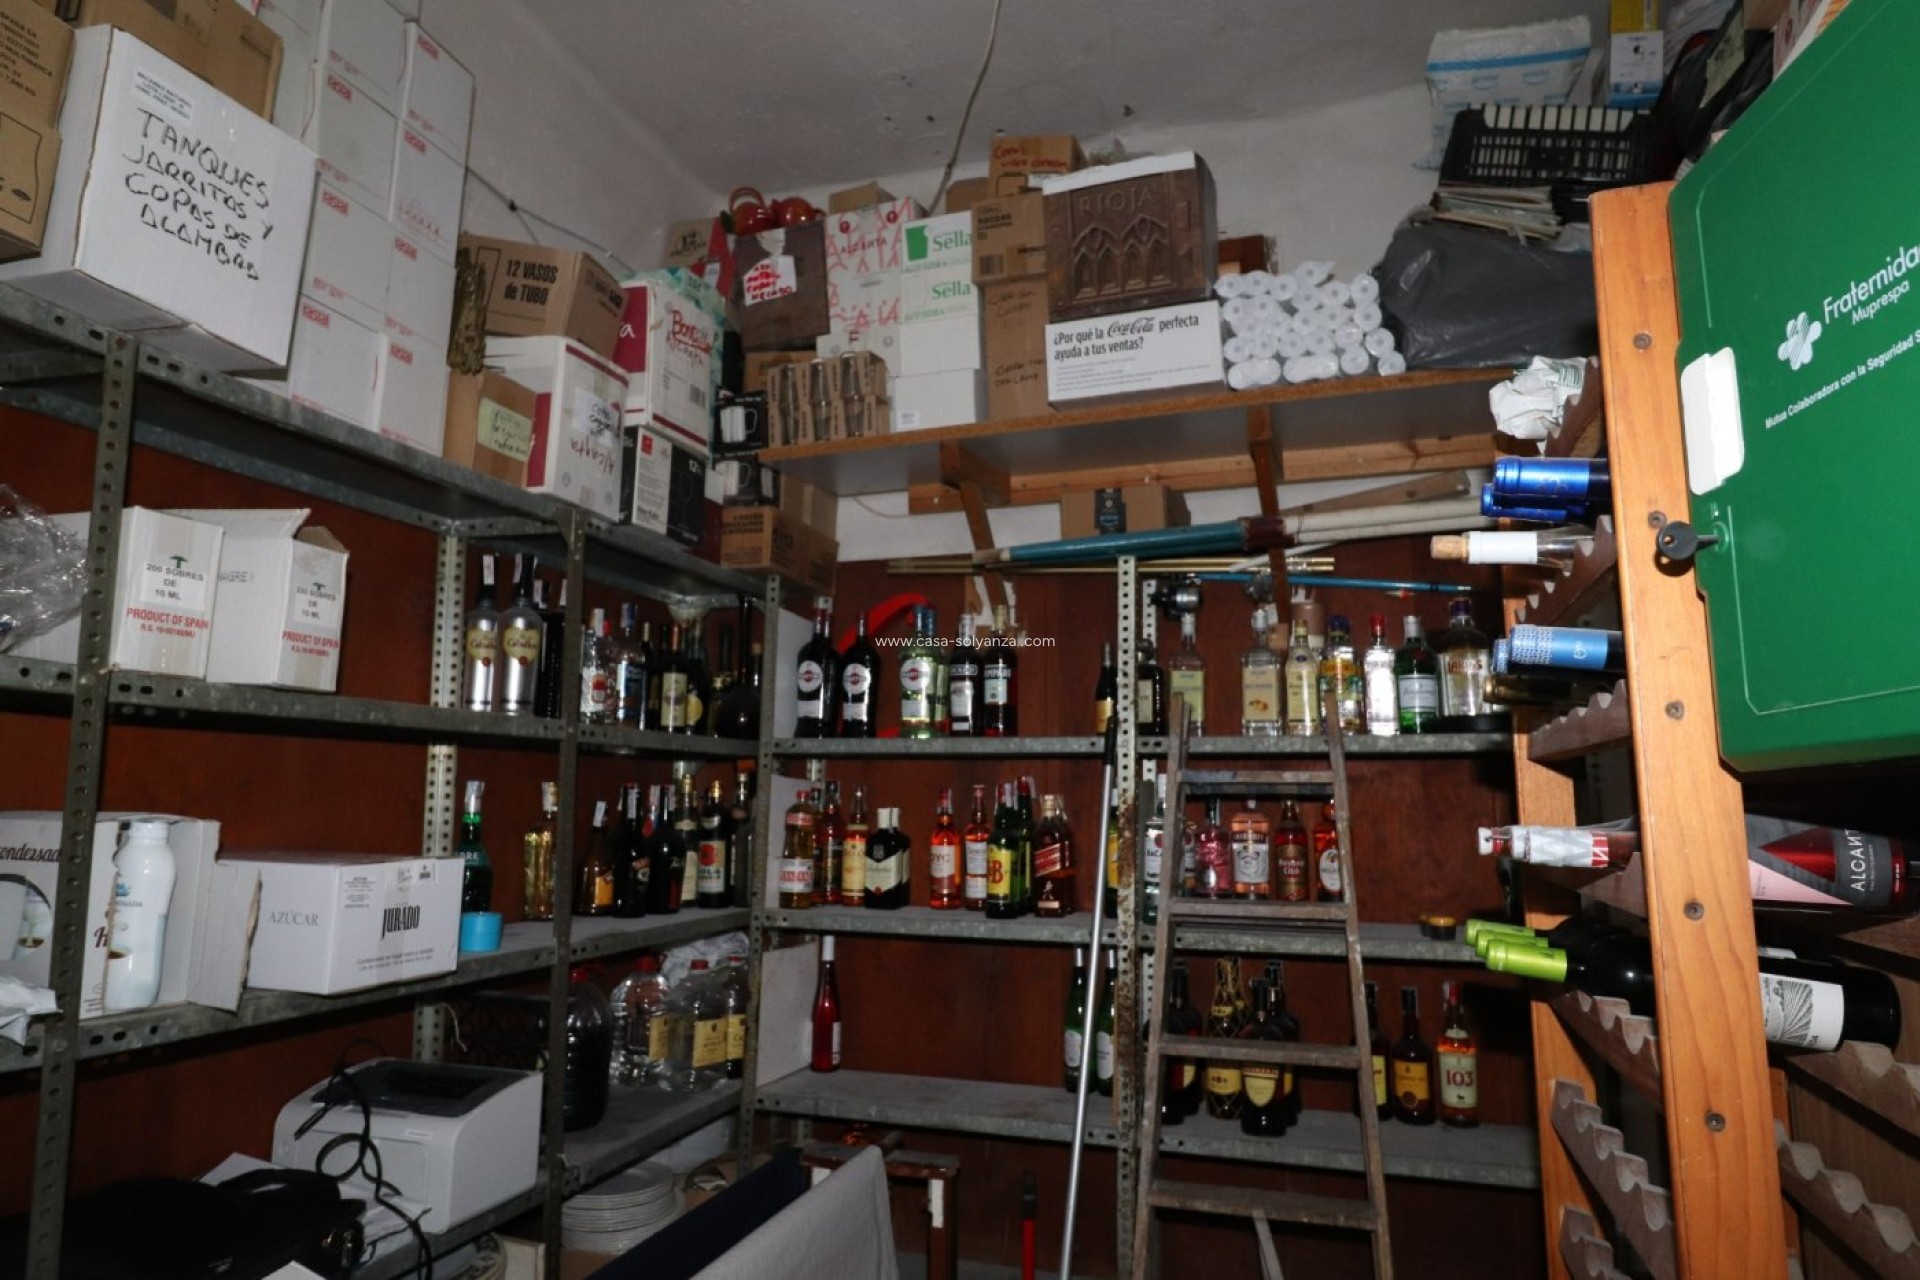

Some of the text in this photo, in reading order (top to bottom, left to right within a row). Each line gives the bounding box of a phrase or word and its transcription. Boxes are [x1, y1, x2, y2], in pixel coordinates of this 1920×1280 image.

[137, 107, 269, 209] TANQUES
[122, 144, 247, 219] JARRITOS
[125, 172, 252, 250] COPAS DE
[506, 259, 558, 285] 12 VASOS
[504, 281, 550, 306] de TUBO
[932, 279, 972, 301] Sella
[1852, 280, 1910, 325] Muprespa
[1053, 331, 1074, 346] ¿Por
[1076, 328, 1093, 344] qué
[1095, 327, 1104, 339] la
[1159, 314, 1200, 335] perfecta
[1055, 336, 1144, 363] ayuda a tus ventas?
[1840, 371, 1857, 386] con
[1866, 333, 1915, 371] Seguridad
[146, 563, 204, 582] 200 SOBRES
[164, 578, 177, 588] DE
[126, 607, 209, 631] PRODUCT OF SPAIN
[282, 630, 312, 644] PRODUCT
[1845, 828, 1866, 892] ALCANT
[270, 908, 319, 927] AZÚCAR
[381, 904, 421, 941] JURADO
[1446, 1069, 1473, 1087] 103
